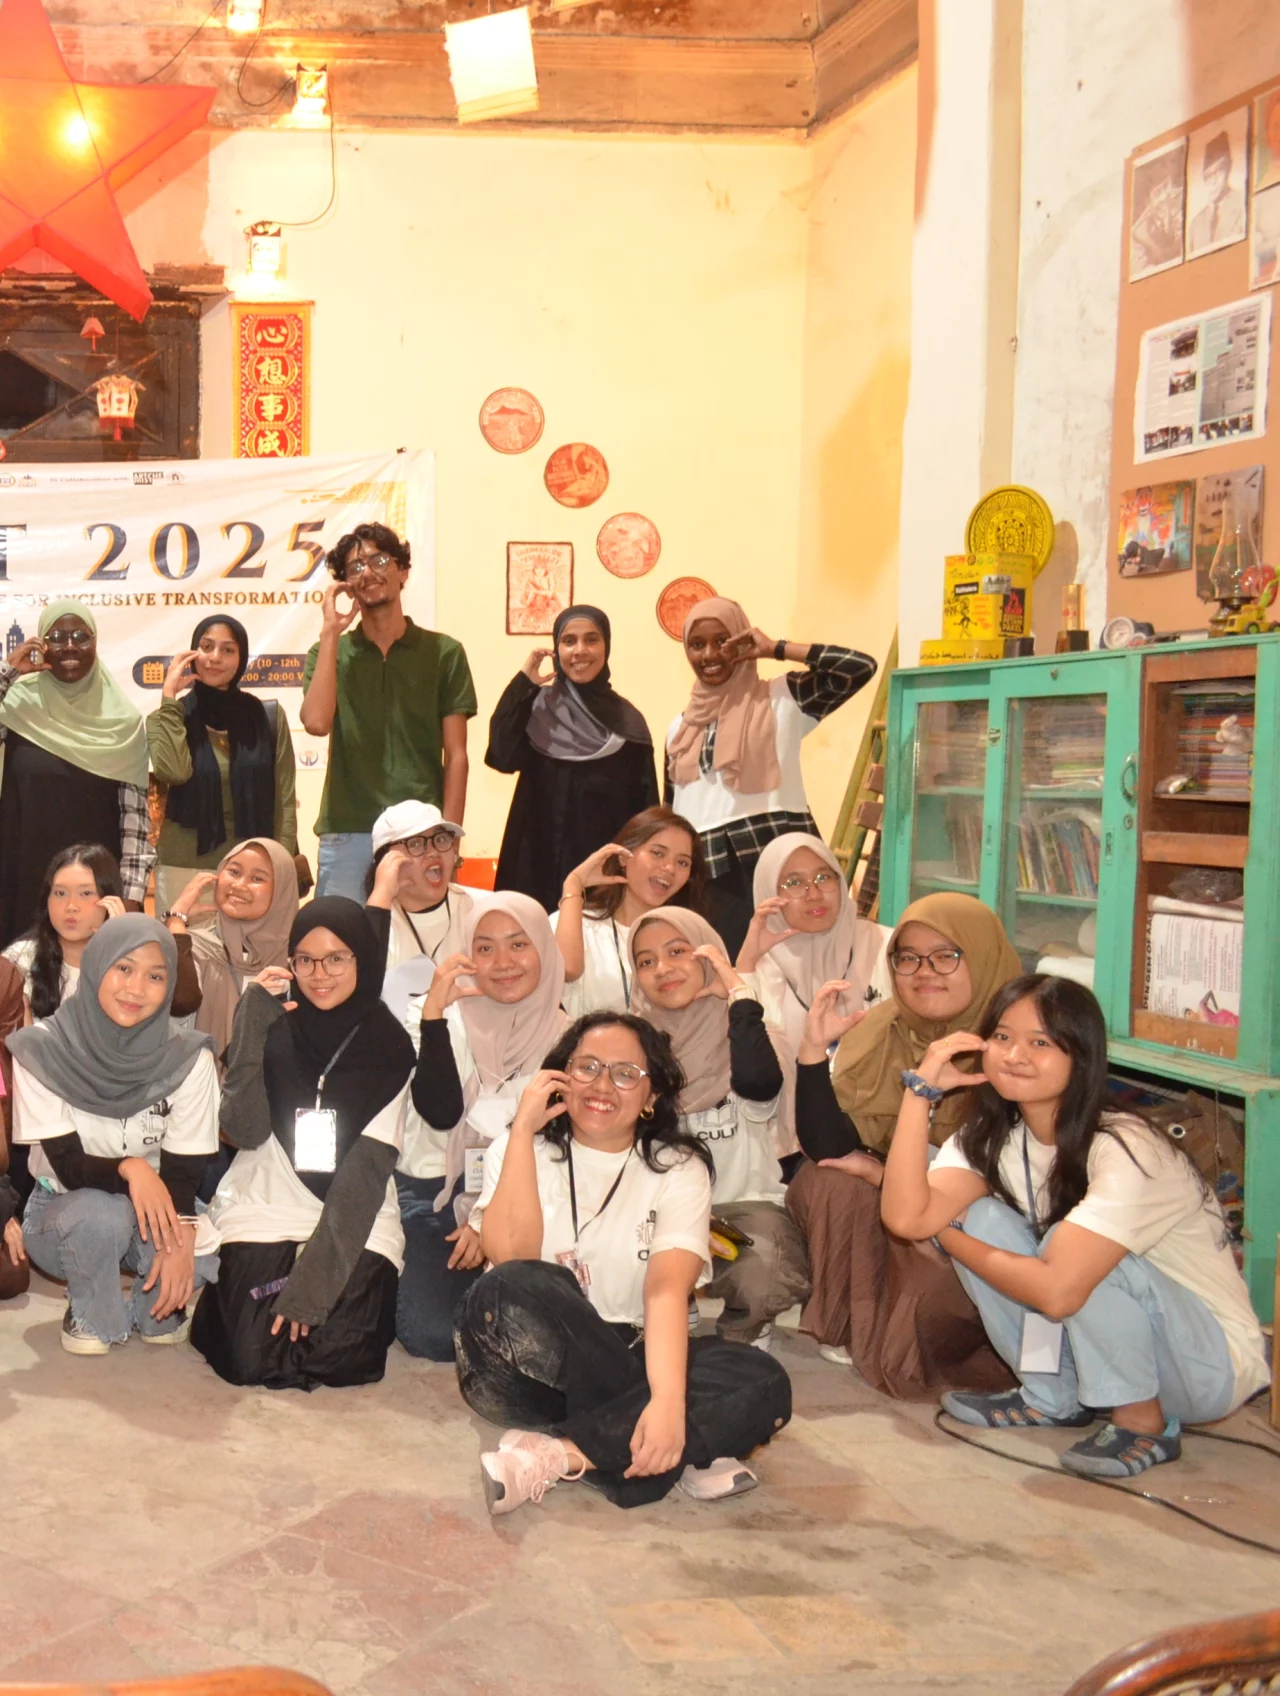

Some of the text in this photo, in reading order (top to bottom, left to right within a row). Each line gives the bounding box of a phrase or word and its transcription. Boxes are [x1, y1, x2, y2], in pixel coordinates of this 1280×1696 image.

[256, 325, 288, 457] 心想事成
[83, 517, 326, 583] 2025
[13, 593, 50, 607] FOR
[163, 591, 325, 606] TRANSFORMATIO
[257, 657, 272, 670] (10
[280, 657, 300, 668] 12th
[268, 672, 295, 682] 20:00
